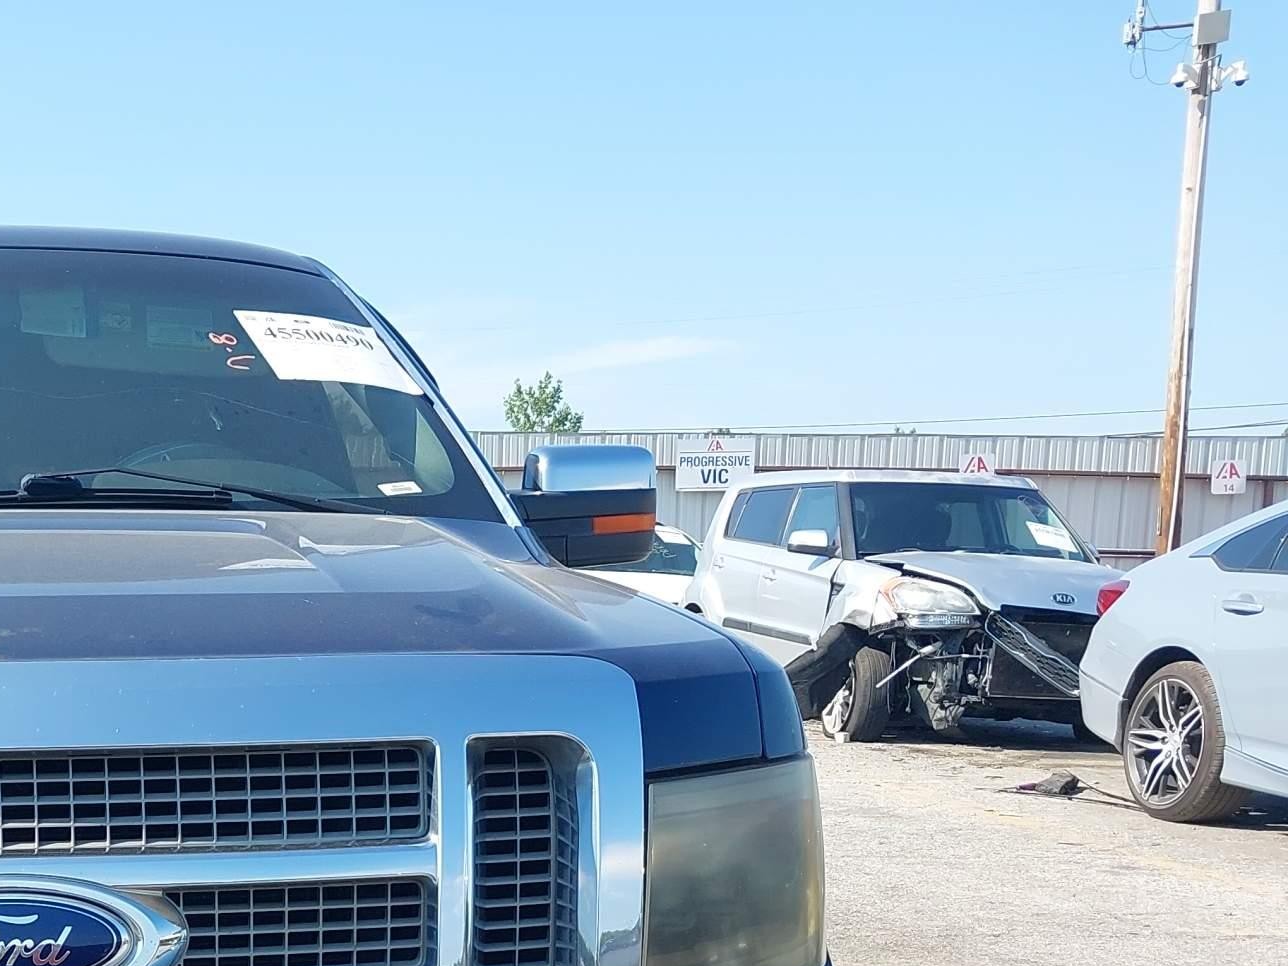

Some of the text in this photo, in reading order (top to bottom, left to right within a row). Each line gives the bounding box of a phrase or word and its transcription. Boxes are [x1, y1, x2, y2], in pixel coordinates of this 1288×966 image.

[264, 326, 374, 351] 45500490
[679, 455, 751, 467] PROGRESSIVE
[700, 468, 729, 484] VIC
[1223, 484, 1235, 493] 14
